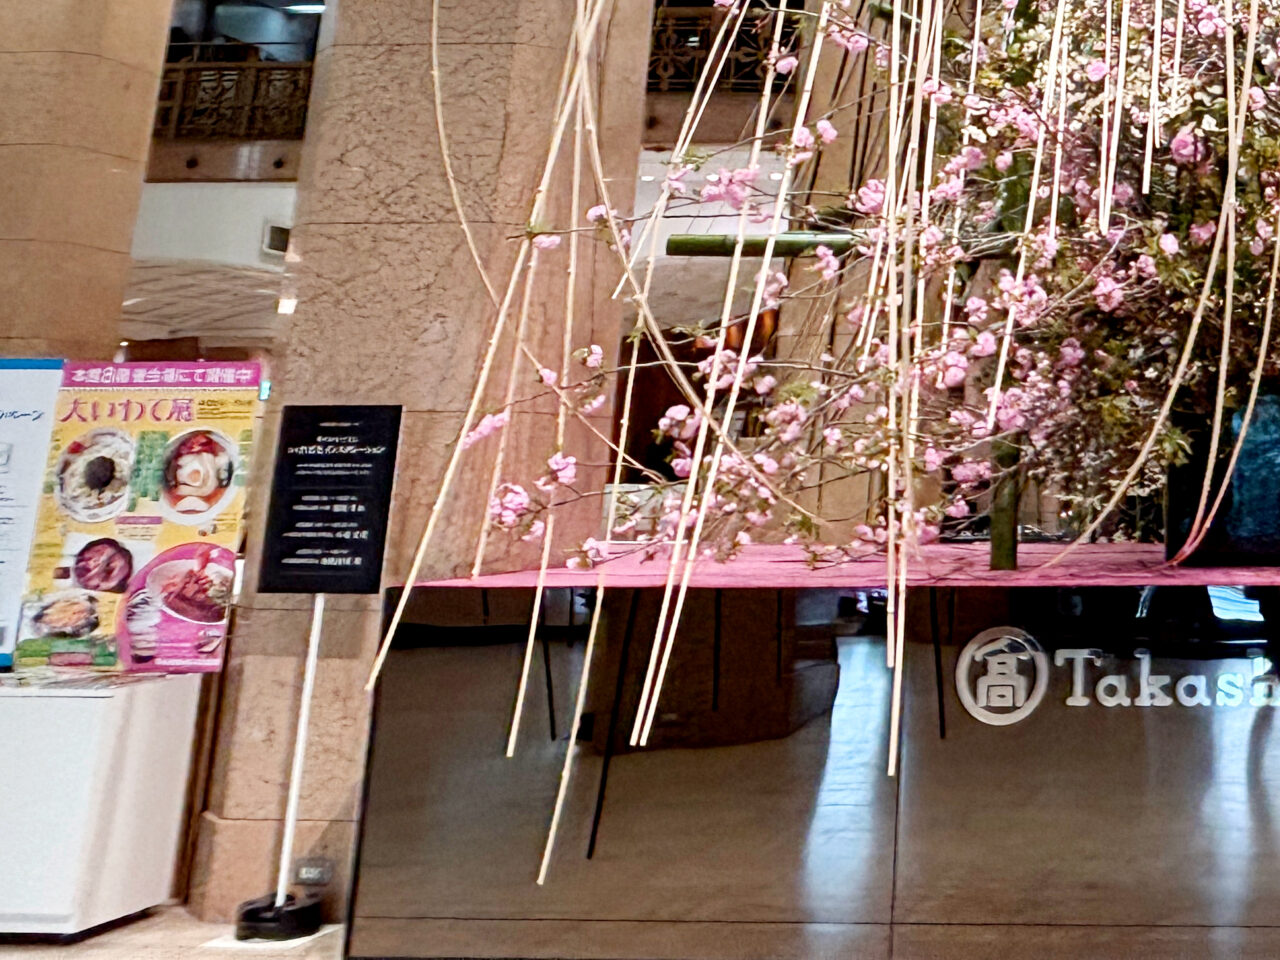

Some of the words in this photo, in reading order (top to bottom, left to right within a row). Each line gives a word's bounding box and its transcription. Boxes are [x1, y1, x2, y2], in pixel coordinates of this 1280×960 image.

[61, 397, 195, 423] 大いわて展
